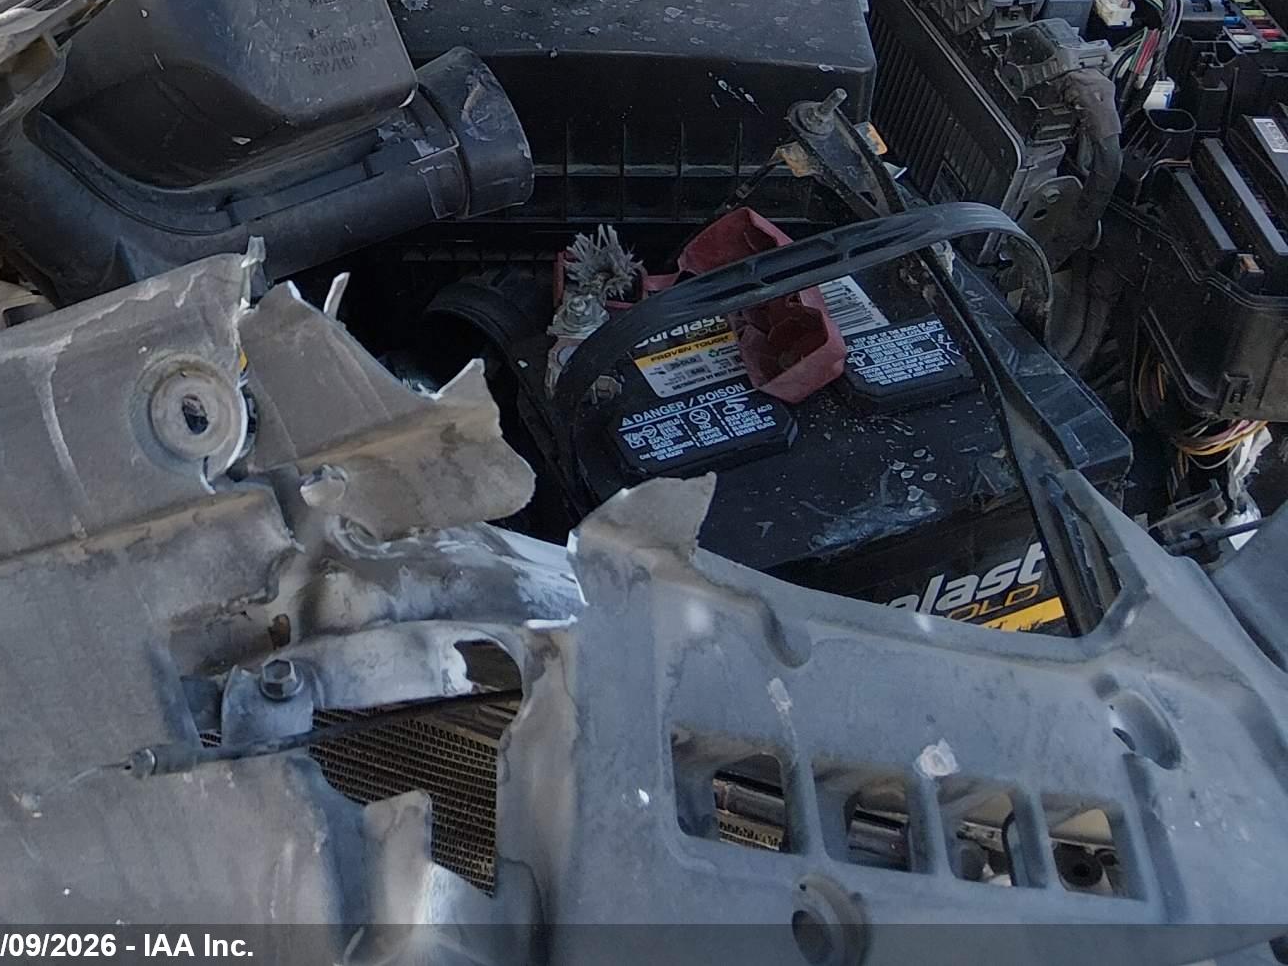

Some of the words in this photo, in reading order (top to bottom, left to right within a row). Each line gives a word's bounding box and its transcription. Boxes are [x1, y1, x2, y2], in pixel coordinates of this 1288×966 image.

[650, 346, 692, 362] PROVEN
[695, 335, 730, 349] TOUGH
[632, 400, 687, 424] DANGER
[688, 397, 694, 408] /
[696, 382, 746, 404] POISON
[946, 584, 1040, 619] OLD
